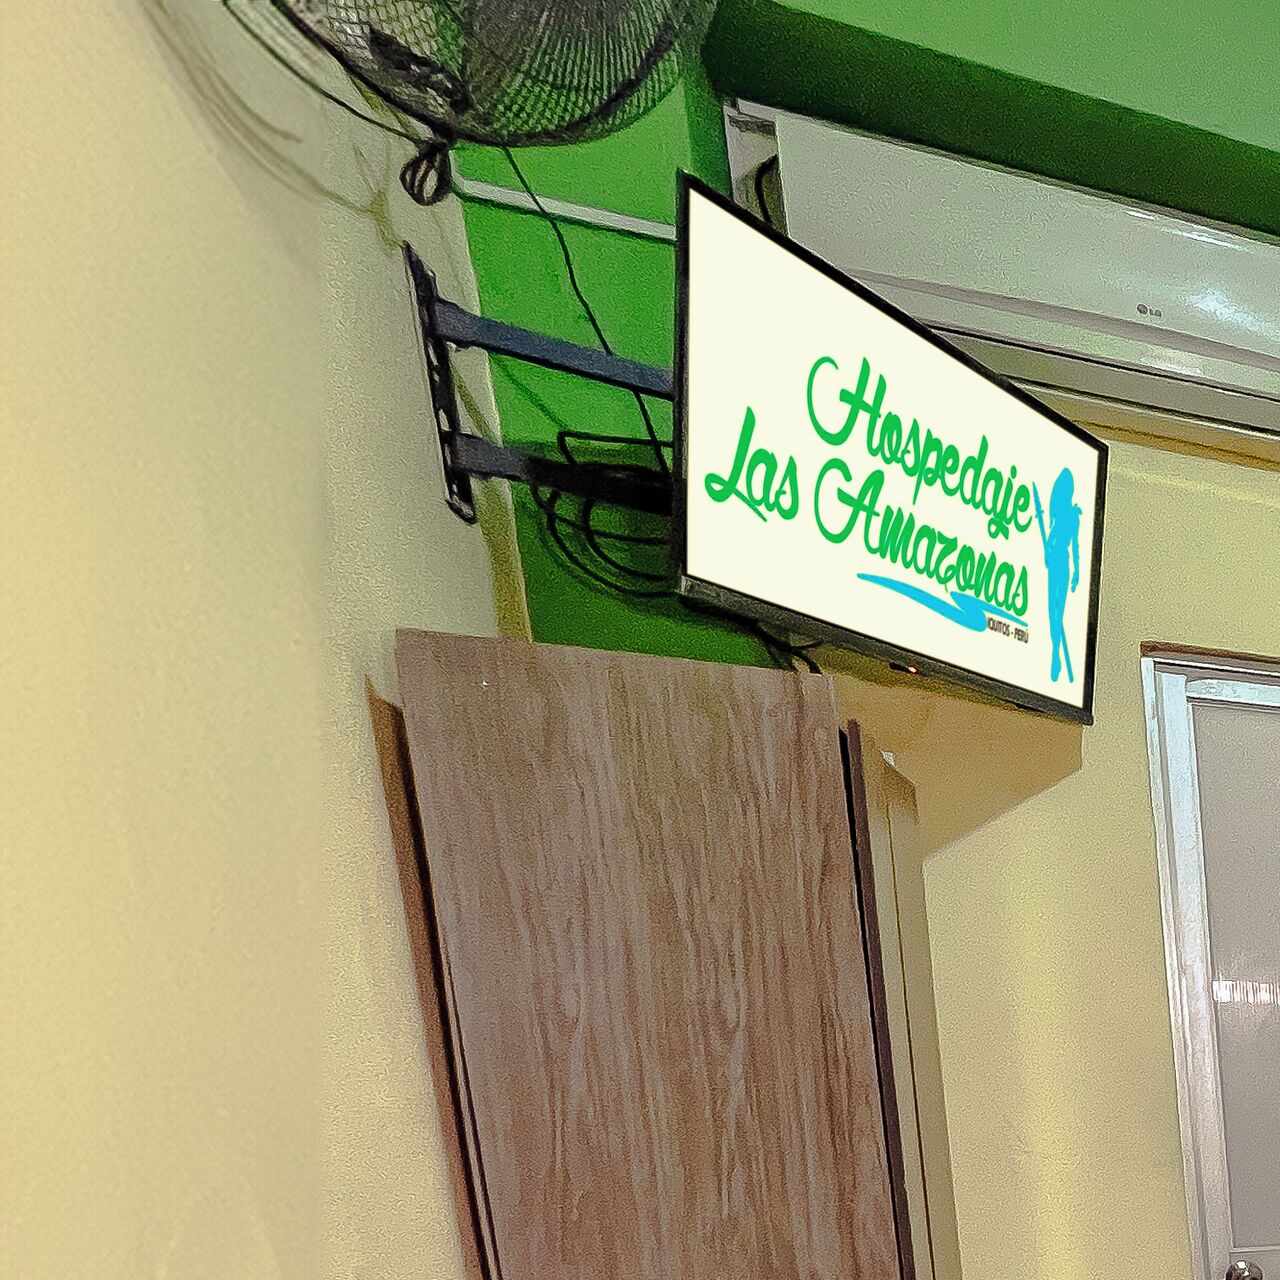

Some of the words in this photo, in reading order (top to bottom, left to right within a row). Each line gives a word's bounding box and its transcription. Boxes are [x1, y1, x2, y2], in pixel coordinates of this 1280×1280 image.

[704, 406, 800, 522] Las
[814, 458, 1029, 617] Amazonas
[806, 356, 1033, 540] Hospedaje
